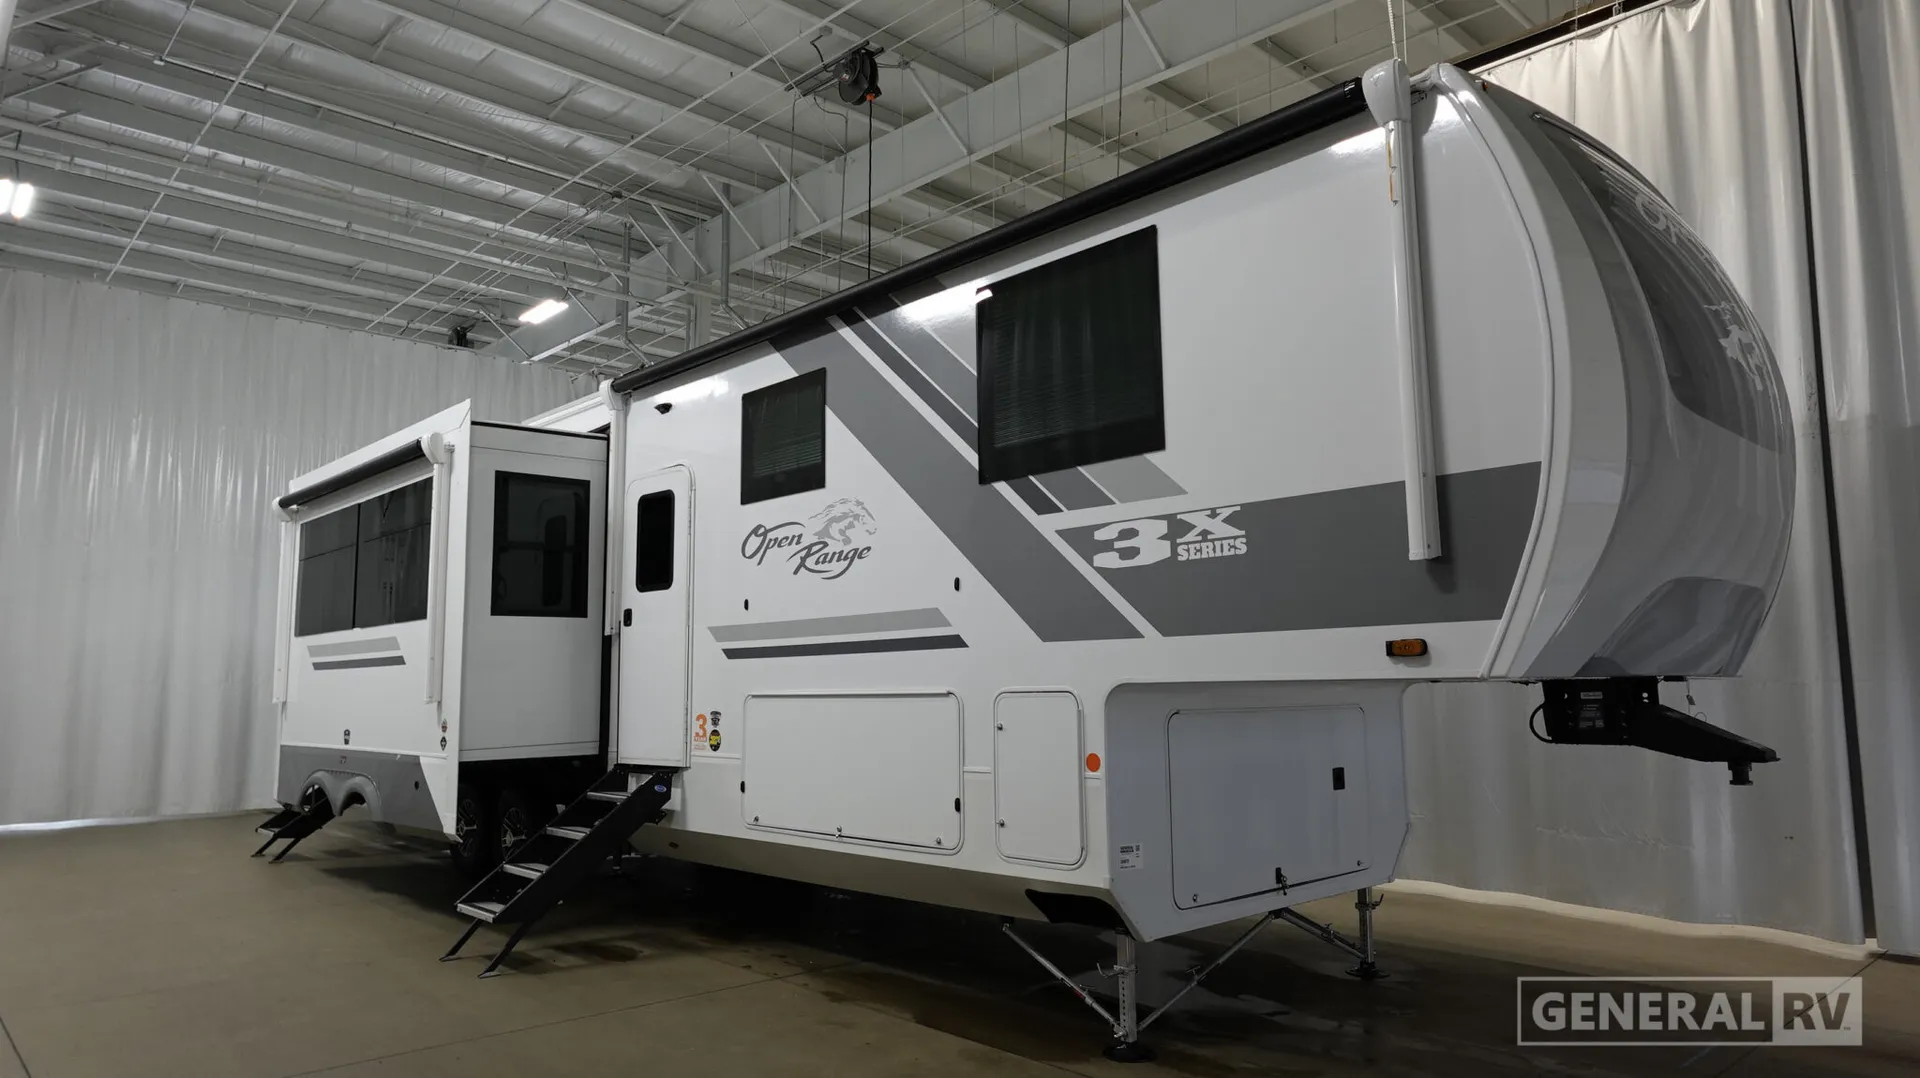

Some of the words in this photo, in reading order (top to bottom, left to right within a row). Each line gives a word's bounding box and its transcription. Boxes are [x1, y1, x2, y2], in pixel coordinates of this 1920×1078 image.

[741, 521, 806, 566] Open
[1177, 537, 1248, 562] SERIES
[786, 540, 873, 580] Range
[695, 713, 708, 737] 3
